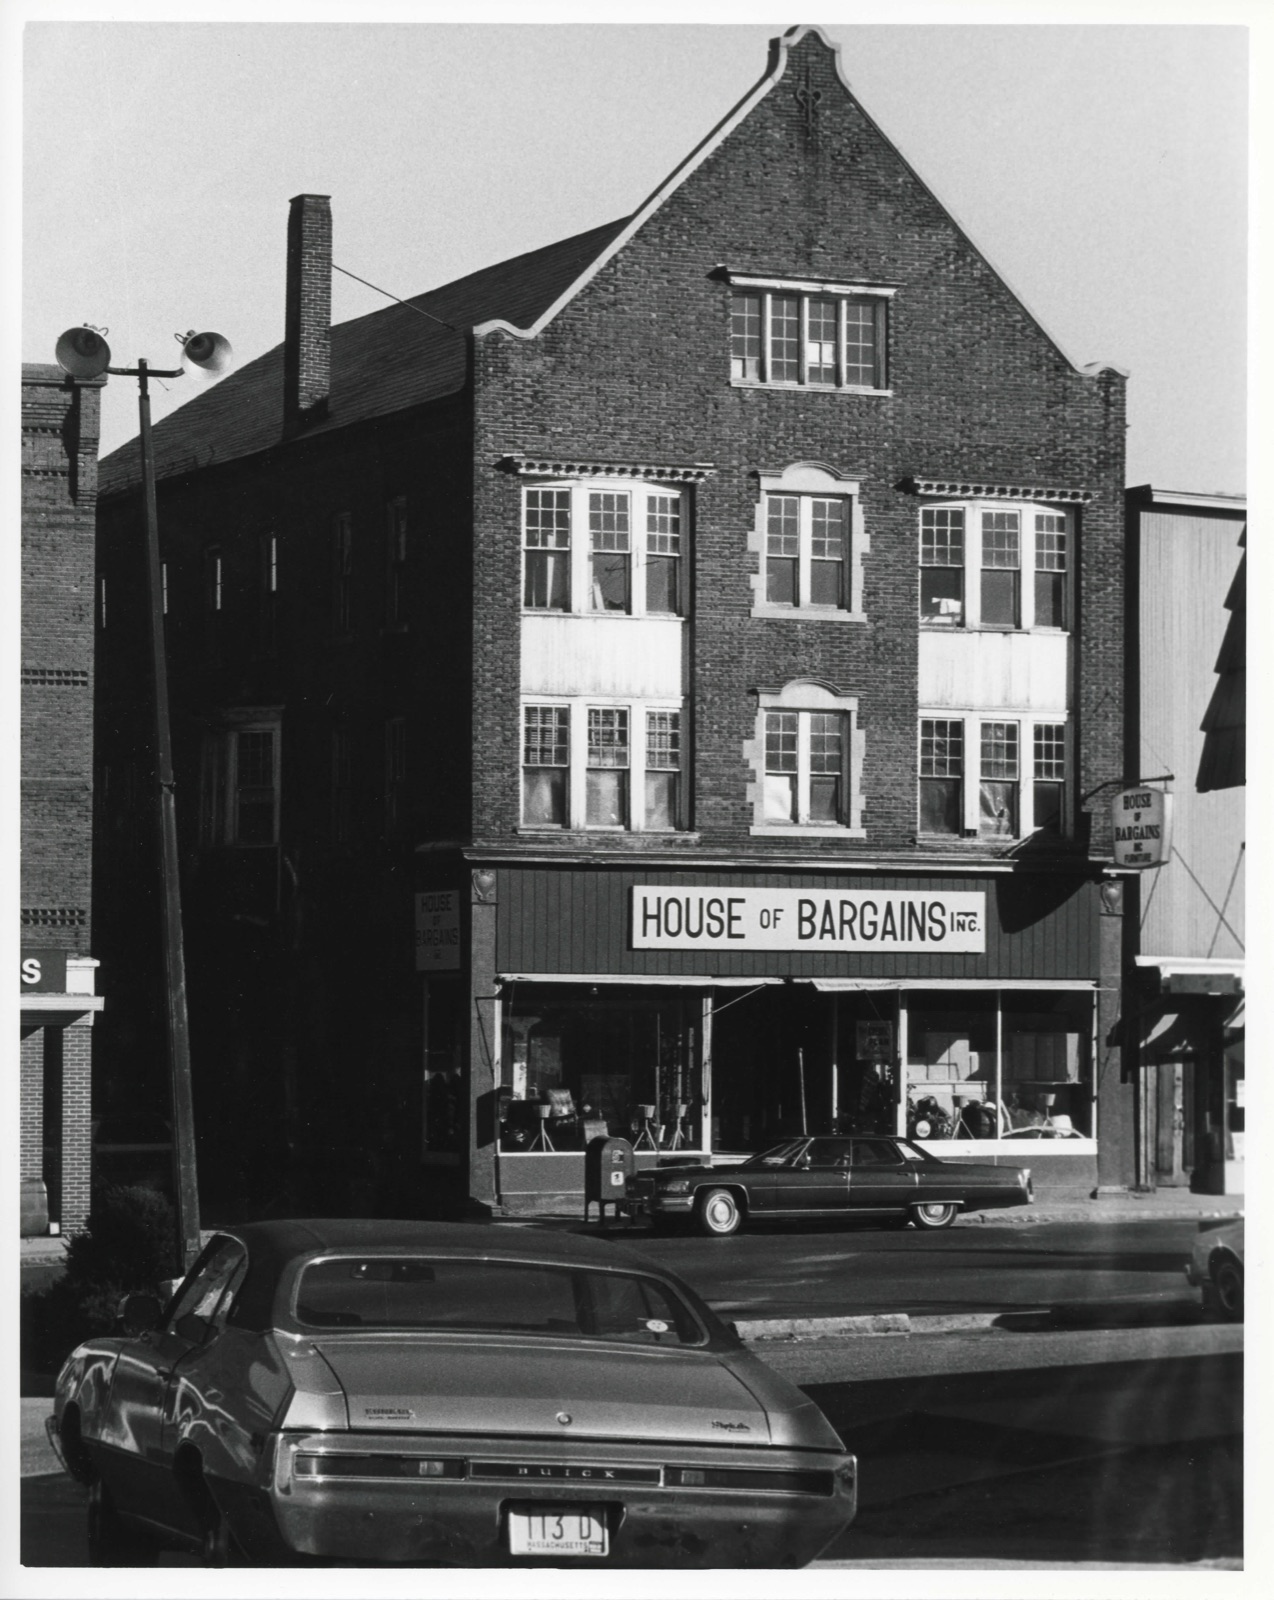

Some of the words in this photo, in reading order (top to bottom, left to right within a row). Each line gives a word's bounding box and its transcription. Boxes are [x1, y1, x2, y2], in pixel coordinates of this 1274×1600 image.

[1122, 793, 1152, 810] HOUSE
[1115, 825, 1160, 841] BARGAINS
[421, 893, 452, 912] HOUSE
[642, 896, 746, 939] HOUSE
[759, 908, 784, 929] OF
[797, 898, 947, 942] BARGAINS
[415, 927, 459, 947] BARGAINS
[518, 1468, 615, 1478] BUICK
[526, 1541, 588, 1549] MASSACHUSETTS
